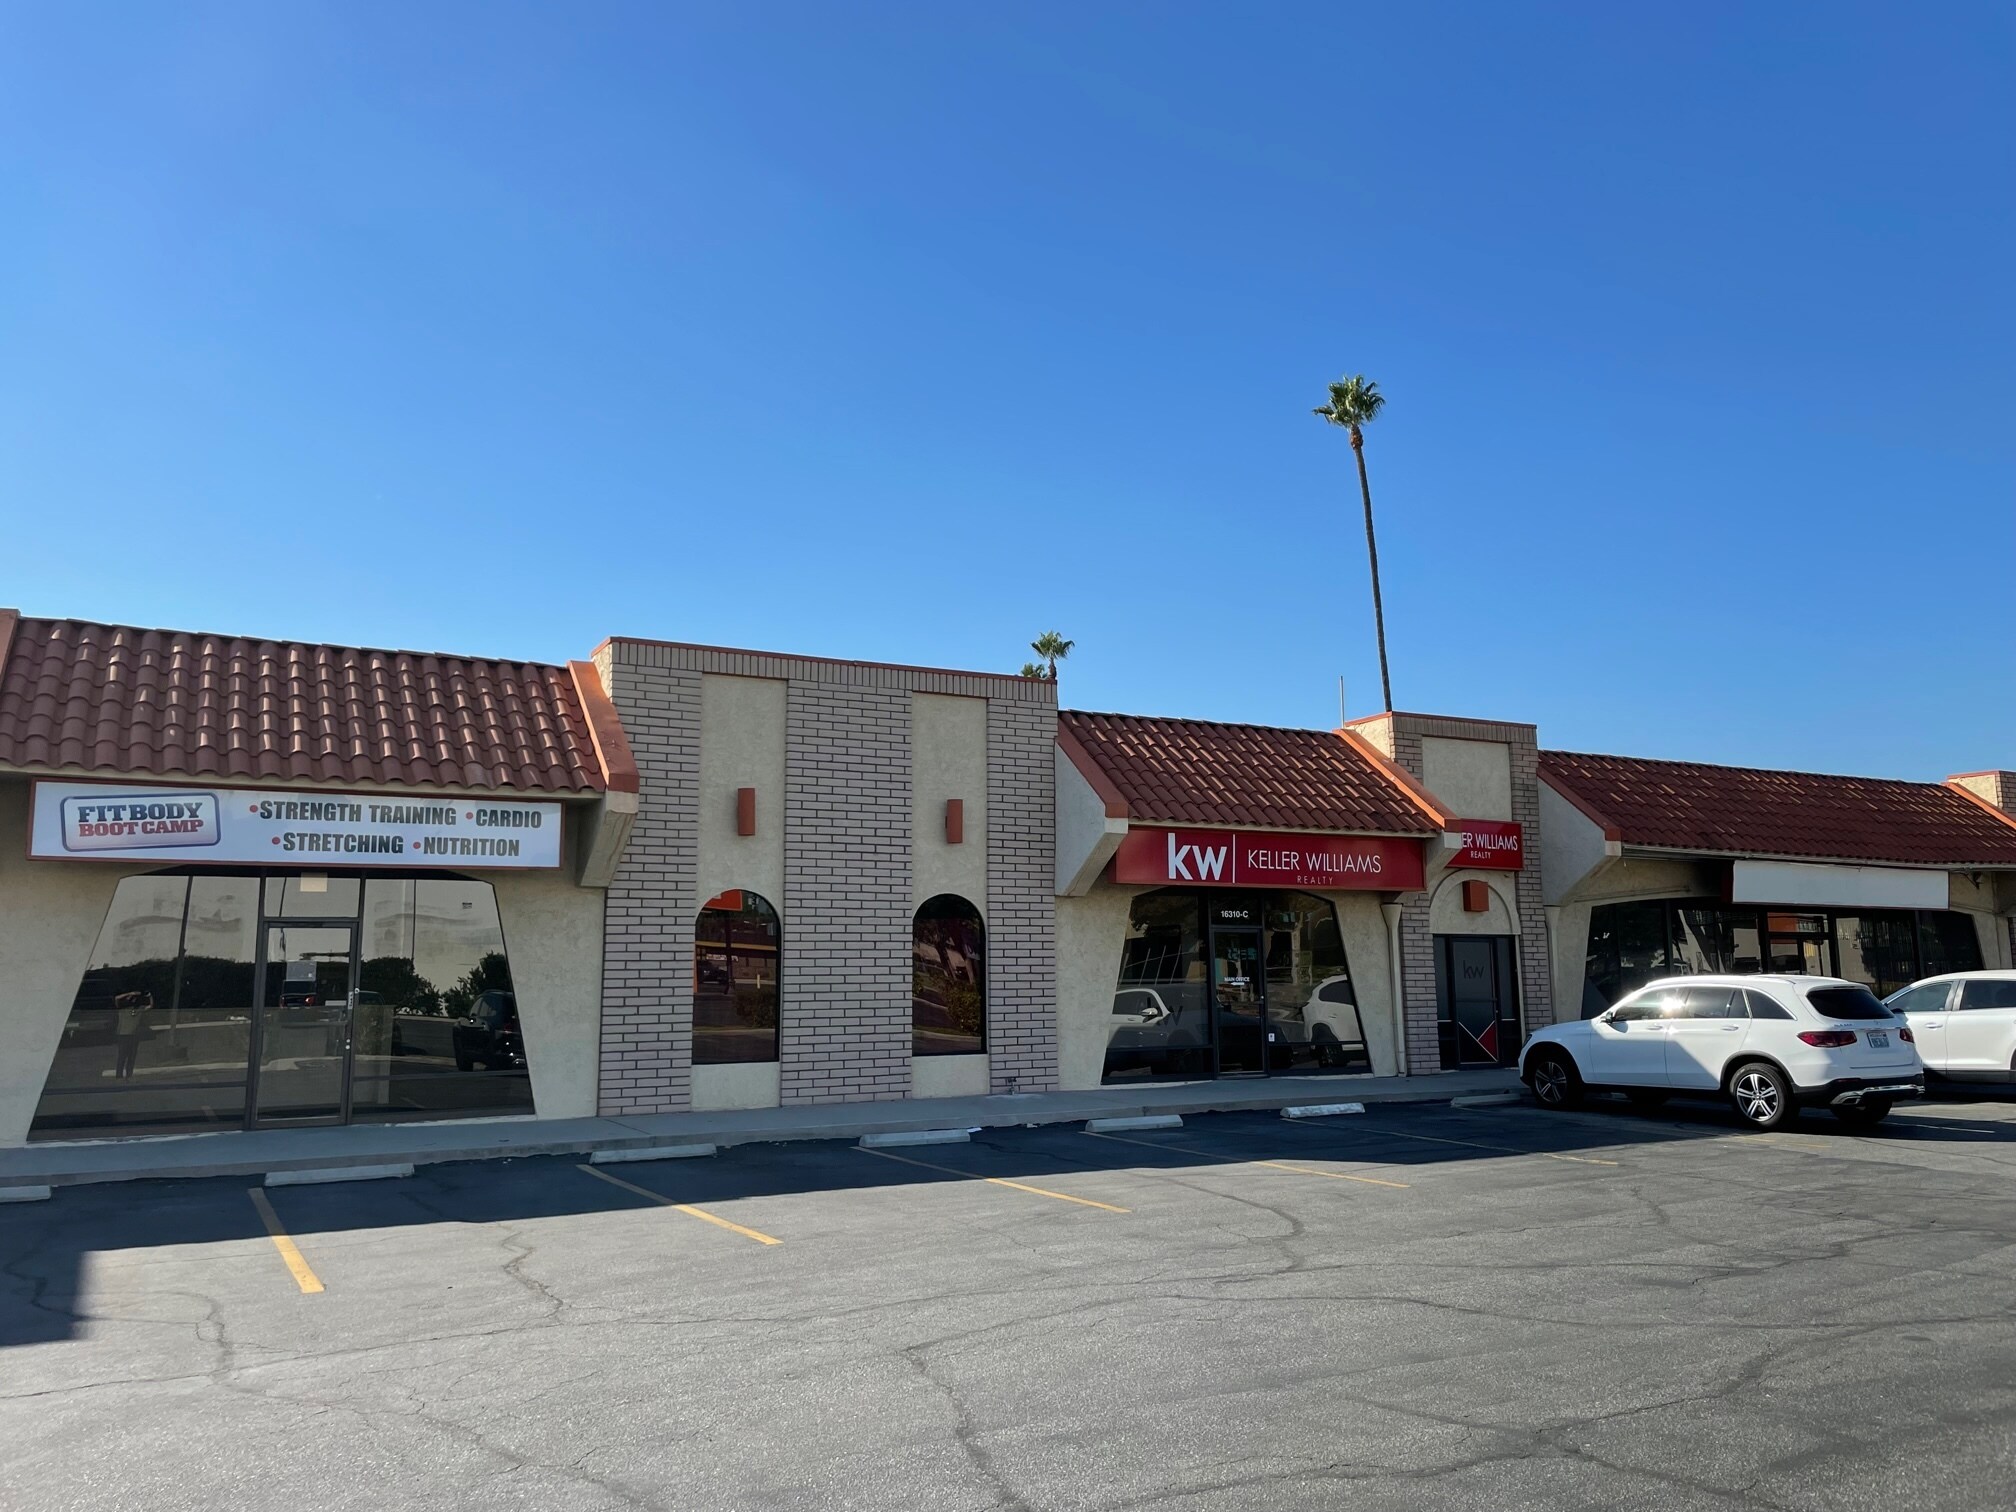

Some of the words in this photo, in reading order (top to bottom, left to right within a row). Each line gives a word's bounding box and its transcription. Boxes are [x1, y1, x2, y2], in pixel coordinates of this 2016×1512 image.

[78, 804, 130, 822] FIT
[130, 802, 202, 821] BODY
[260, 800, 361, 822] STRENGTH
[369, 804, 457, 826] TRAINING
[475, 808, 542, 828] CARDIO
[79, 821, 139, 837] BOOT
[141, 819, 204, 834] CAMP
[283, 832, 404, 854] STRETCHING
[423, 837, 520, 857] NUTRITION
[1475, 833, 1518, 851] WILLIAMS
[1247, 849, 1300, 871] KELLER
[1304, 851, 1382, 874] WILLIAMS
[1471, 850, 1491, 859] REALTY
[1296, 875, 1334, 885] REALTY
[1220, 910, 1249, 919] 16310-C
